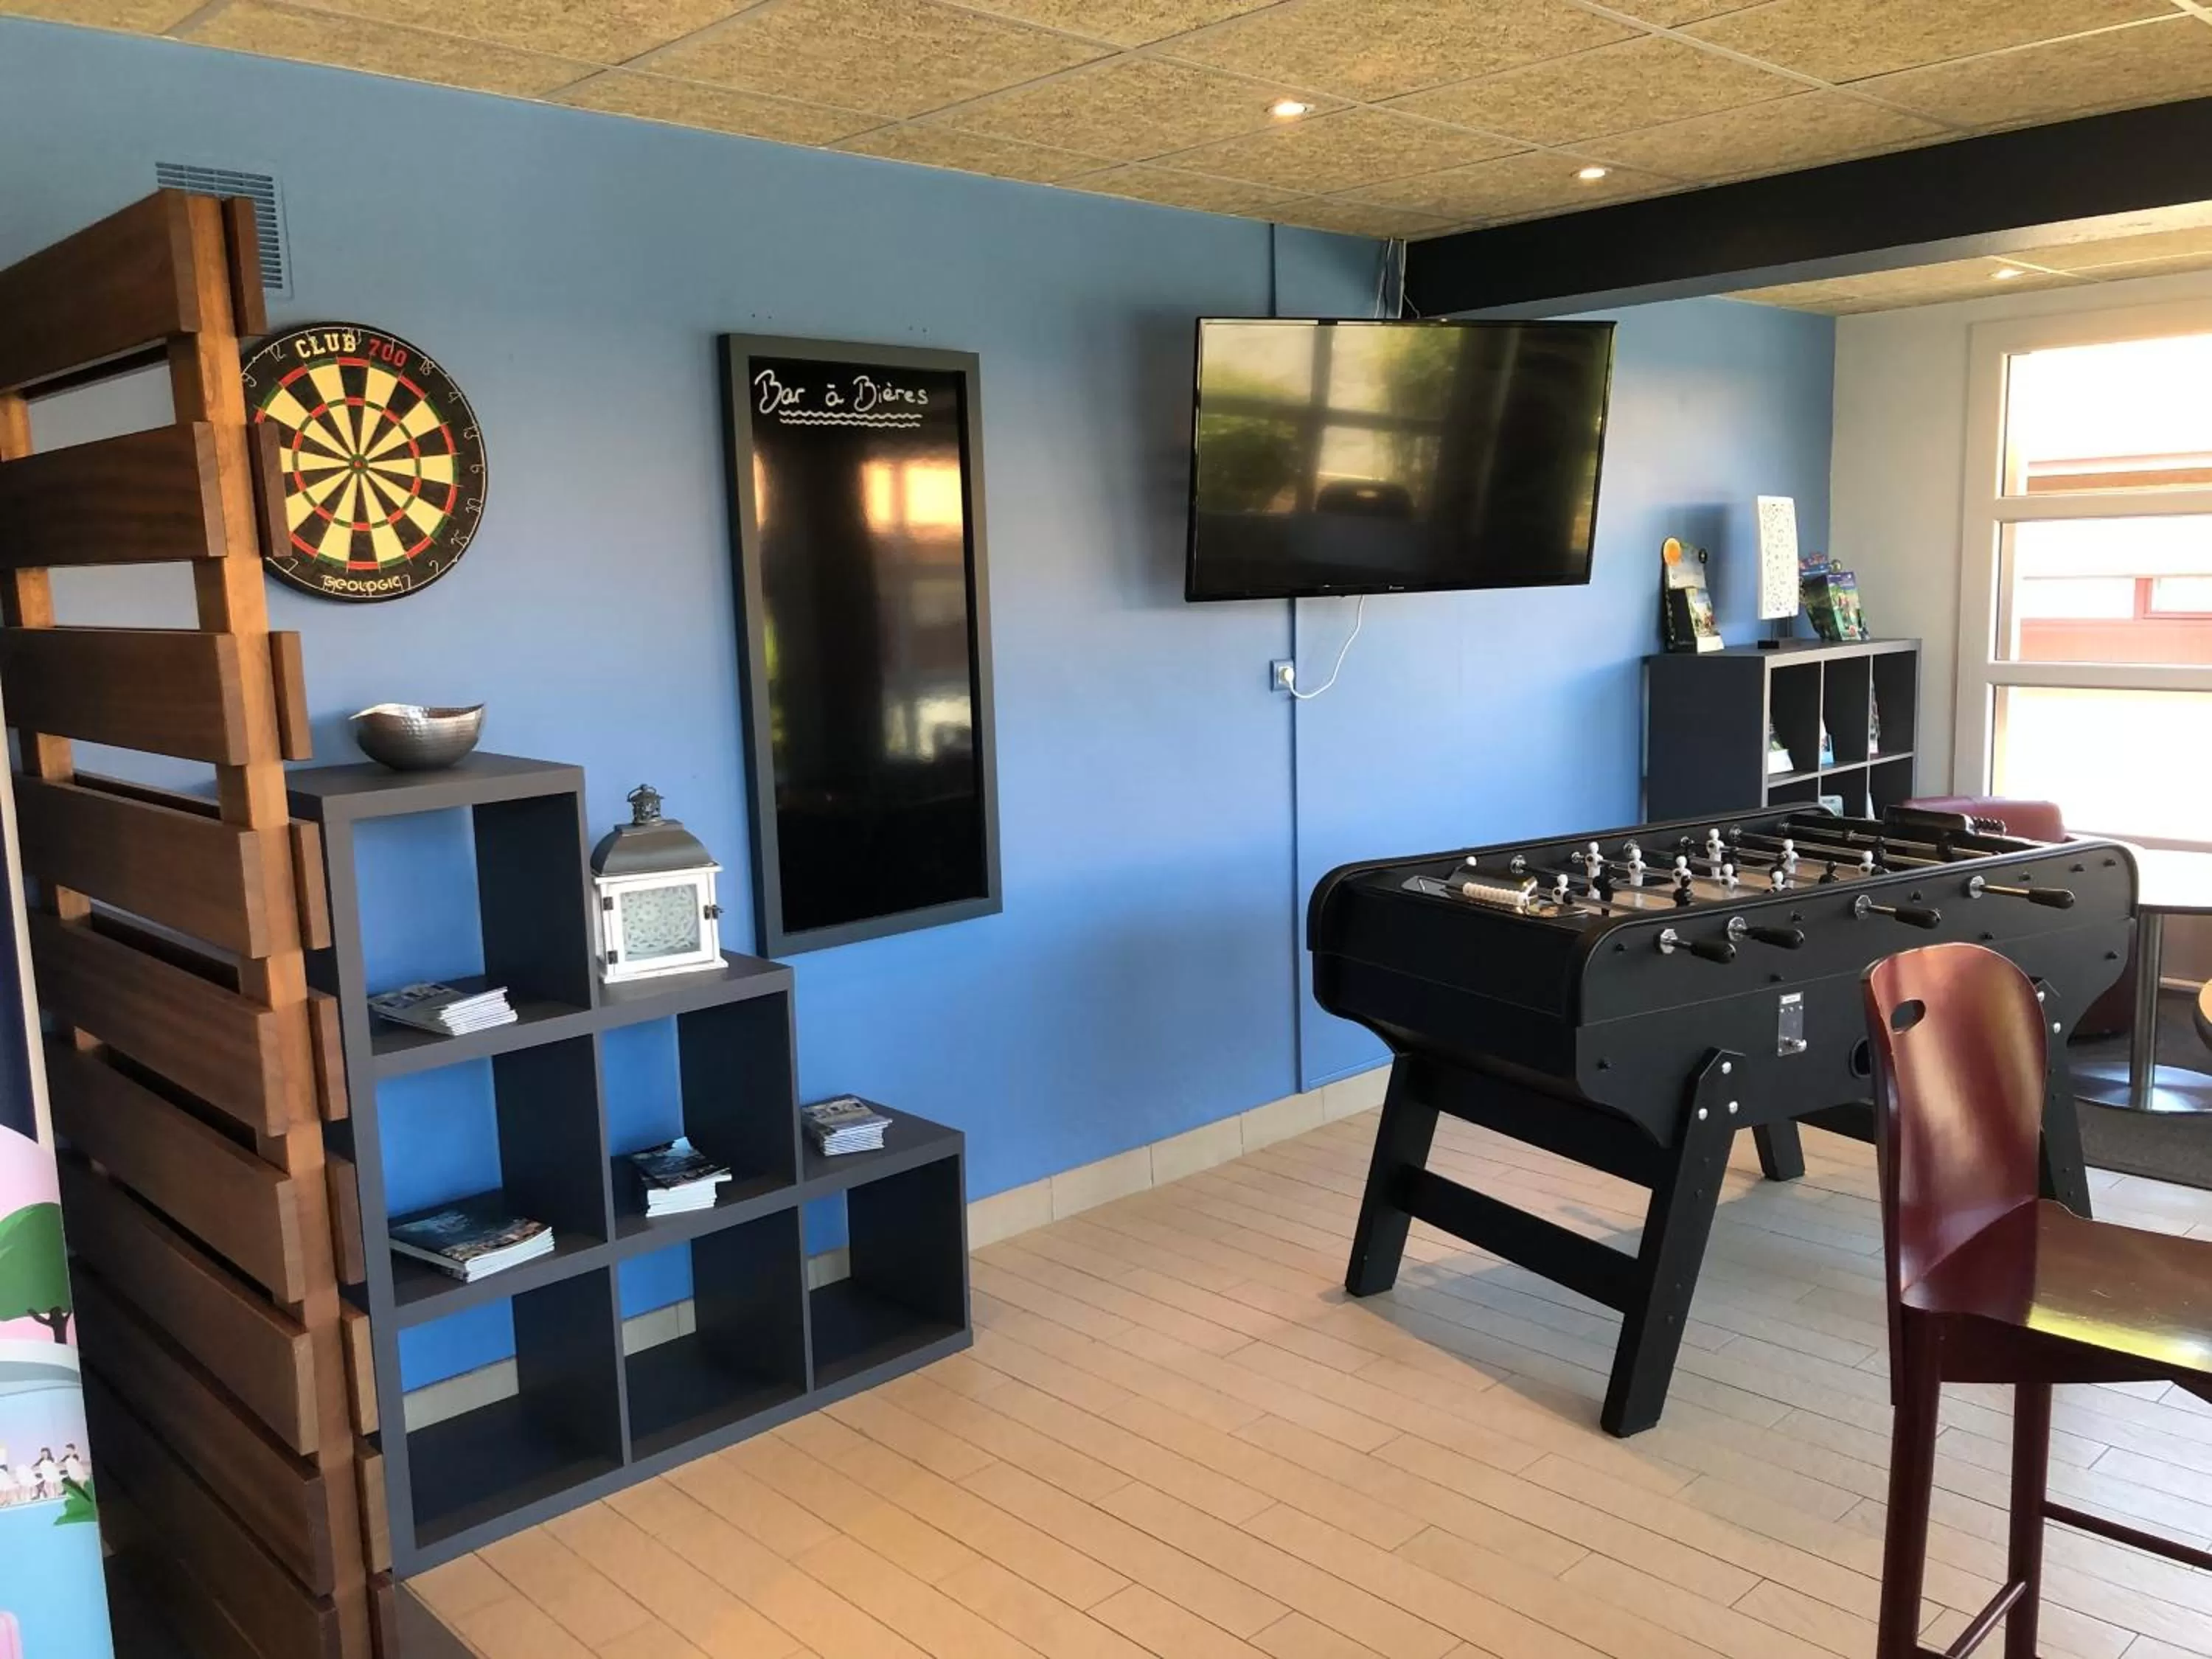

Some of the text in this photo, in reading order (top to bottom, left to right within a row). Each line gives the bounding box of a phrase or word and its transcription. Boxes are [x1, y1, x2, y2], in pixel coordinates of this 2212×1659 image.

[296, 333, 357, 358] CLUB
[368, 338, 408, 367] 700
[754, 369, 806, 414] Bar
[852, 375, 929, 412] Bières
